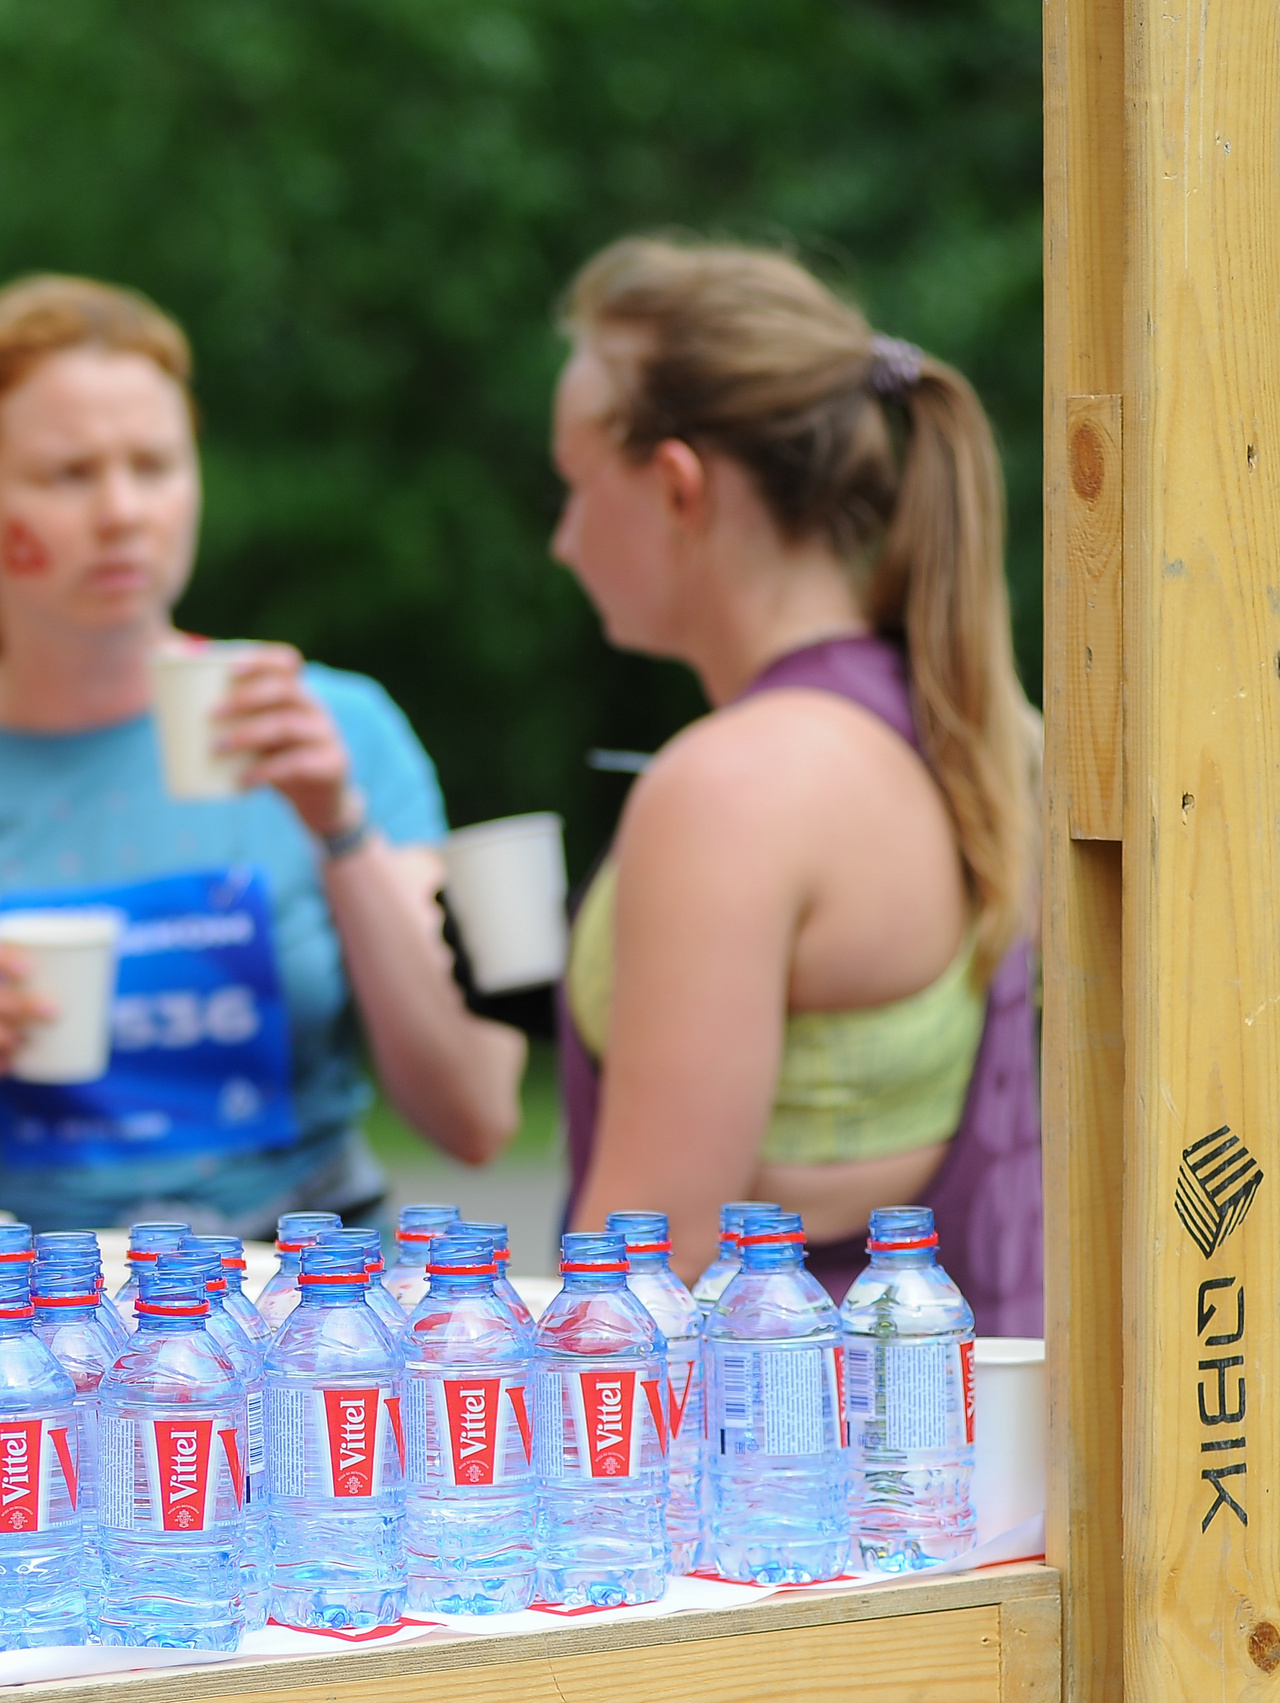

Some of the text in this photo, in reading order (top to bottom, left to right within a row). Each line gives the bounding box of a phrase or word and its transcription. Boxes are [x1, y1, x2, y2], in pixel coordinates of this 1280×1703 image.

[339, 1398, 366, 1471] Vittel
[460, 1388, 488, 1460] Vittel
[596, 1381, 624, 1452] Vittel
[1197, 1276, 1248, 1535] QBIK
[0, 1430, 29, 1506] Vittel
[169, 1429, 198, 1505] Vittel
